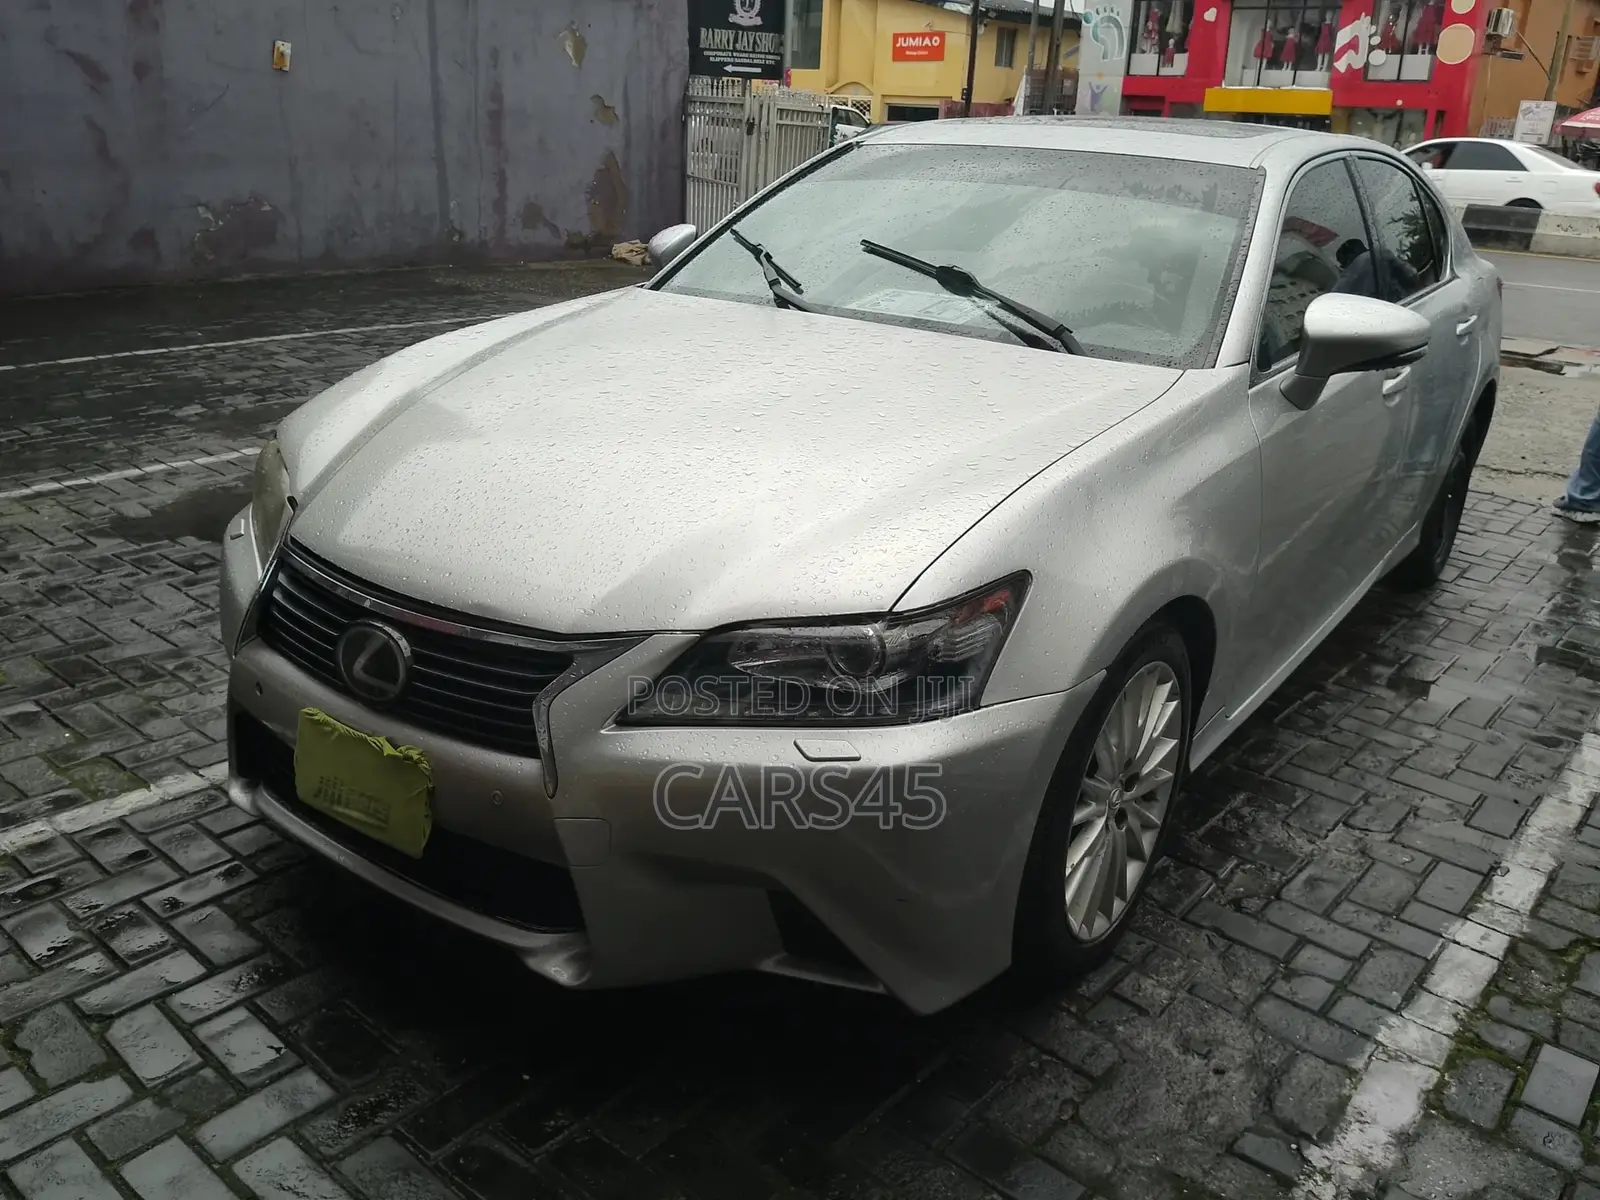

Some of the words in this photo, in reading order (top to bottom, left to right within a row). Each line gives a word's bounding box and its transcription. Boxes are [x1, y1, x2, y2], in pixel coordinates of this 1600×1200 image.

[699, 27, 736, 50] BARRY
[736, 30, 756, 52] JAY
[755, 32, 784, 54] SHO
